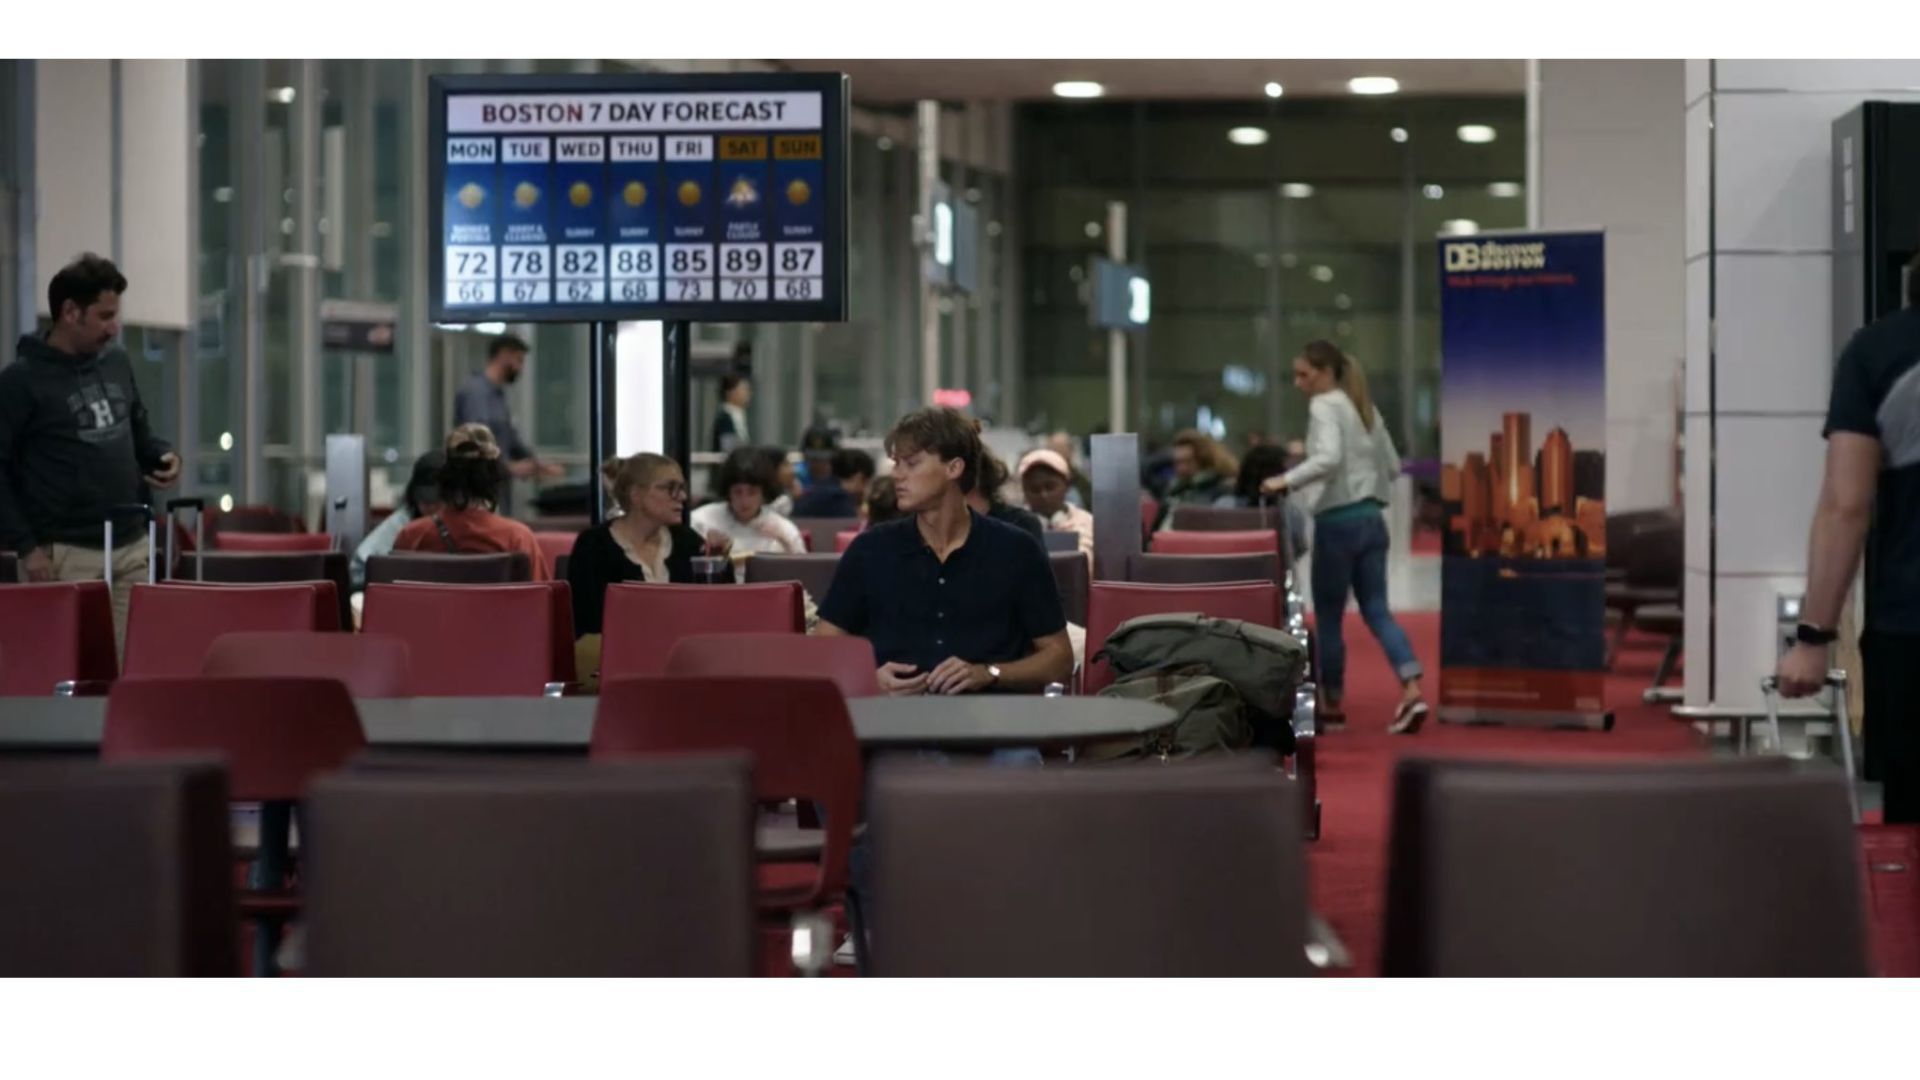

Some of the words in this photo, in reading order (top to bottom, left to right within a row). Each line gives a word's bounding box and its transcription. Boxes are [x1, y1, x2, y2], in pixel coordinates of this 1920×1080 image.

[482, 103, 583, 123] BOSTON
[589, 103, 602, 122] 7
[609, 102, 656, 122] DAY
[662, 101, 786, 121] FORECAST
[450, 143, 493, 158] MON
[509, 143, 543, 157] TUE
[560, 142, 600, 156] WED
[616, 141, 653, 156] THU
[675, 141, 703, 155] FRI
[727, 140, 759, 155] SAT
[780, 140, 817, 155] SUN
[456, 251, 488, 275] 72
[509, 251, 543, 274] 78
[563, 250, 598, 274] 82
[618, 249, 653, 273] 88
[672, 249, 707, 273] 85
[726, 248, 762, 272] 89
[781, 248, 815, 272] 87
[1445, 242, 1480, 272] DB
[1480, 254, 1546, 270] BOSTON
[459, 280, 484, 301] 66
[514, 279, 538, 301] 67
[568, 279, 593, 301] 62
[622, 279, 648, 301] 68
[678, 278, 702, 300] 73
[731, 278, 757, 299] 70
[786, 278, 811, 299] 68
[90, 399, 114, 429] H
